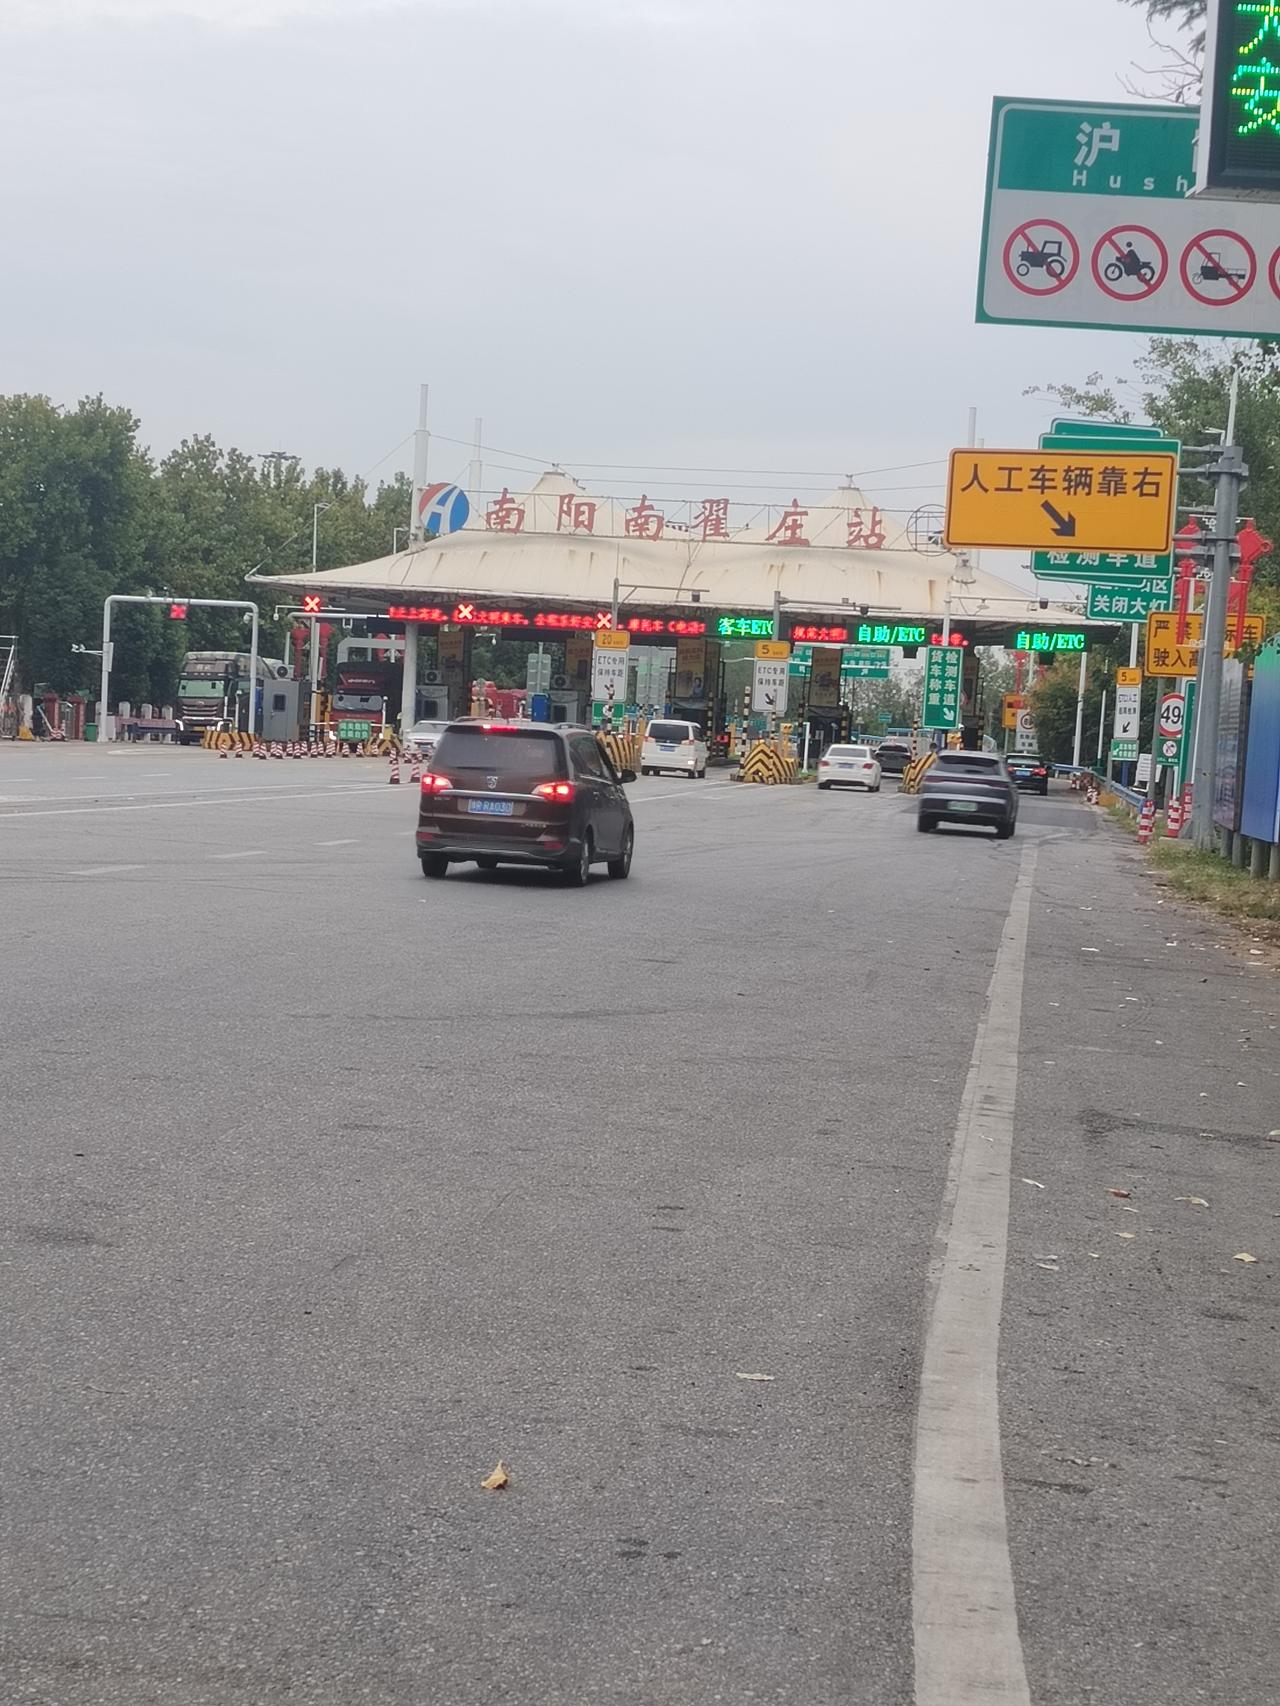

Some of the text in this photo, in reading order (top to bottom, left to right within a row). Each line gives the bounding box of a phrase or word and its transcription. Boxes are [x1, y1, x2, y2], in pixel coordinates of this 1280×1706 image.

[1072, 169, 1188, 192] Hush
[960, 463, 1163, 498] 人工车辆靠右
[485, 487, 887, 550] 南阳南翟庄站
[1093, 594, 1168, 615] 关闭大灯
[858, 623, 926, 644] 自助/ETC
[1016, 631, 1085, 652] 自助/ETC
[761, 644, 770, 655] 5
[597, 655, 625, 666] ETC专用
[757, 666, 786, 675] ETC专用
[927, 649, 944, 705] 货车称重
[942, 651, 959, 706] 检测车道
[1121, 671, 1128, 682] 5
